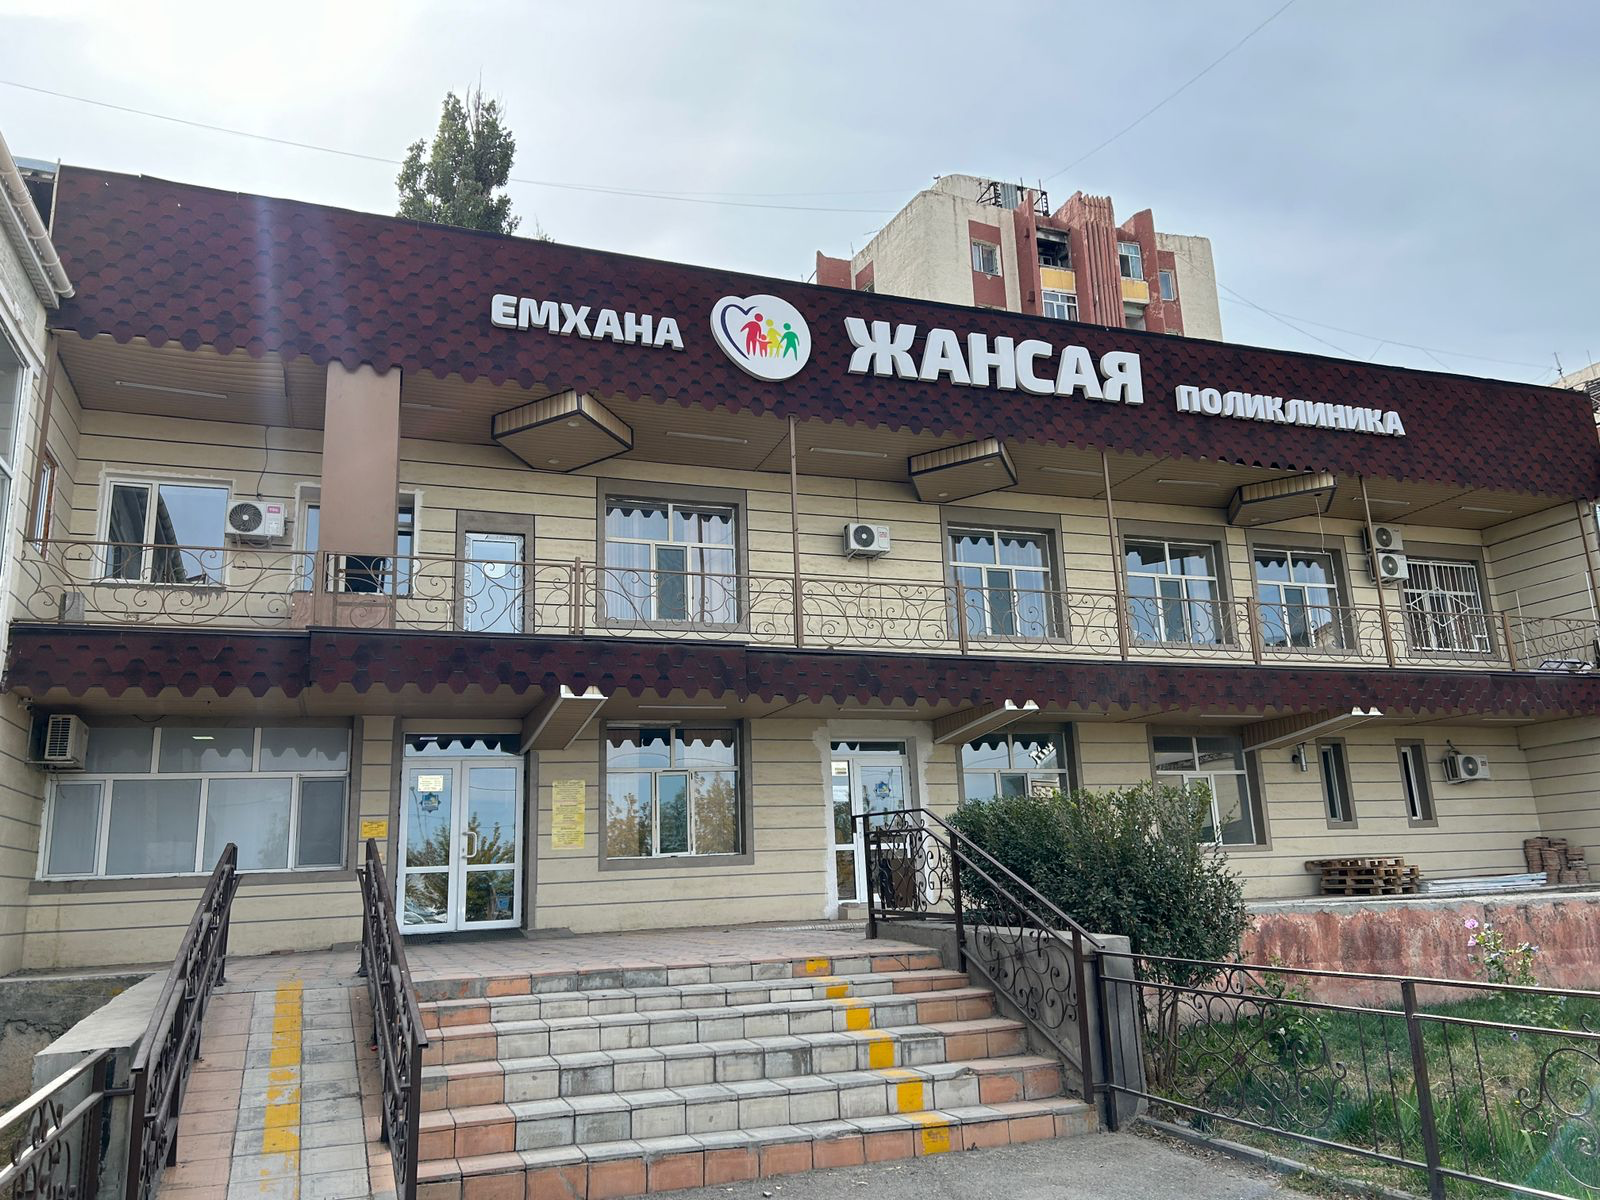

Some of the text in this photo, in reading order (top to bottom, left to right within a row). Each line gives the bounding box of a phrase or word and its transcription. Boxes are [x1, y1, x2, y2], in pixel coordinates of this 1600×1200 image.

[491, 294, 684, 350] ЕМХАНА
[844, 317, 1144, 404] ЖАНСАЯ
[1175, 384, 1406, 436] ПОЛИКЛИНИКА
